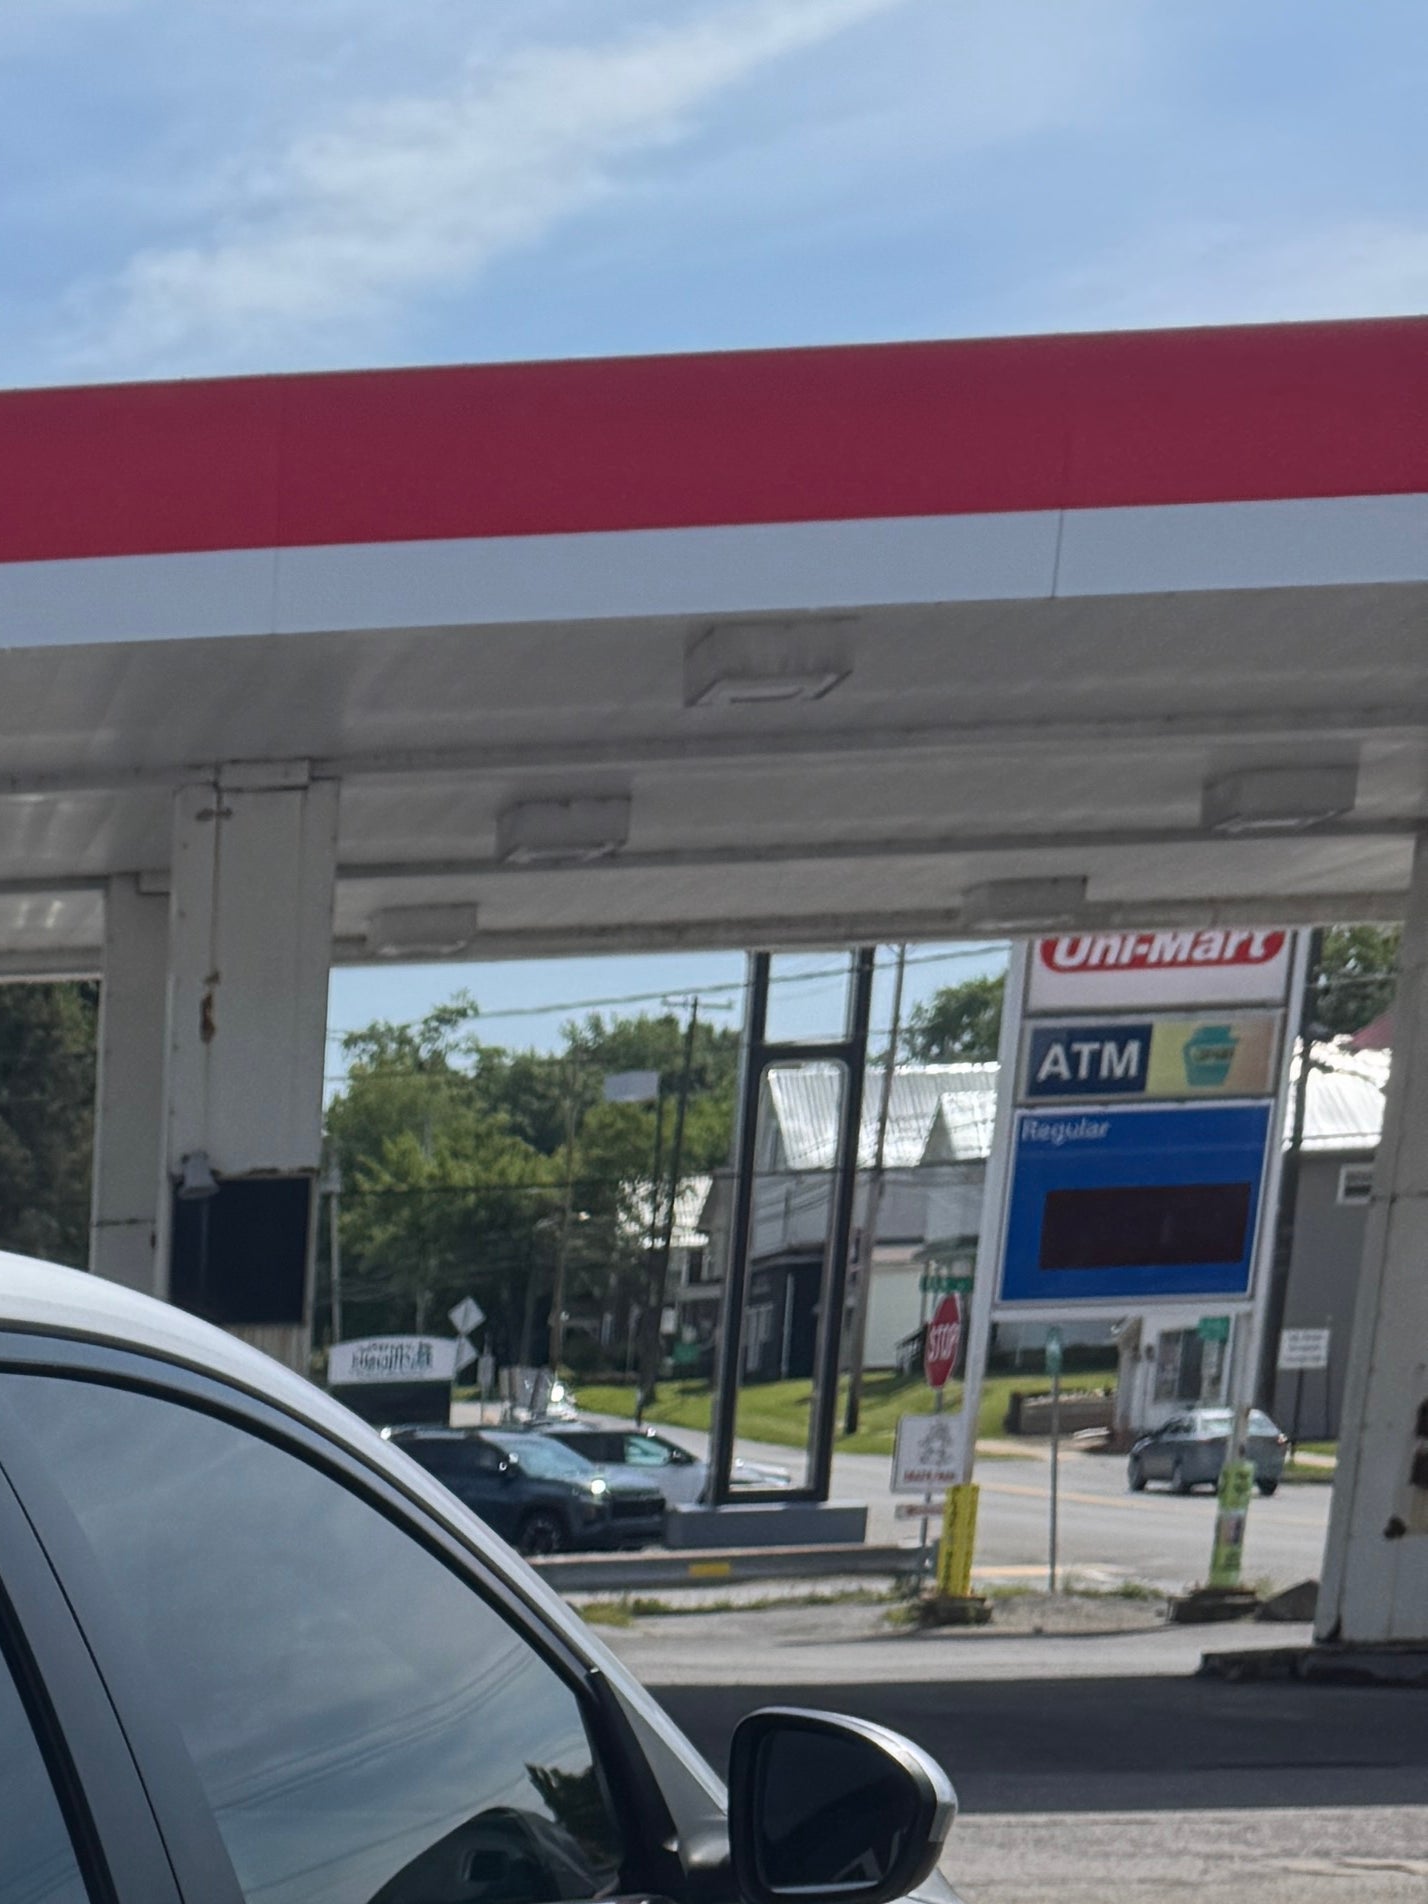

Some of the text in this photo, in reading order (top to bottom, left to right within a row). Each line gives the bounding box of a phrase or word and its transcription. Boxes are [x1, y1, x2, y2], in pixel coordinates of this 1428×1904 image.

[1052, 931, 1268, 967] Uni-Mart
[1037, 1038, 1142, 1082] ATM
[1021, 1118, 1111, 1146] Regular
[927, 1321, 960, 1361] STOP
